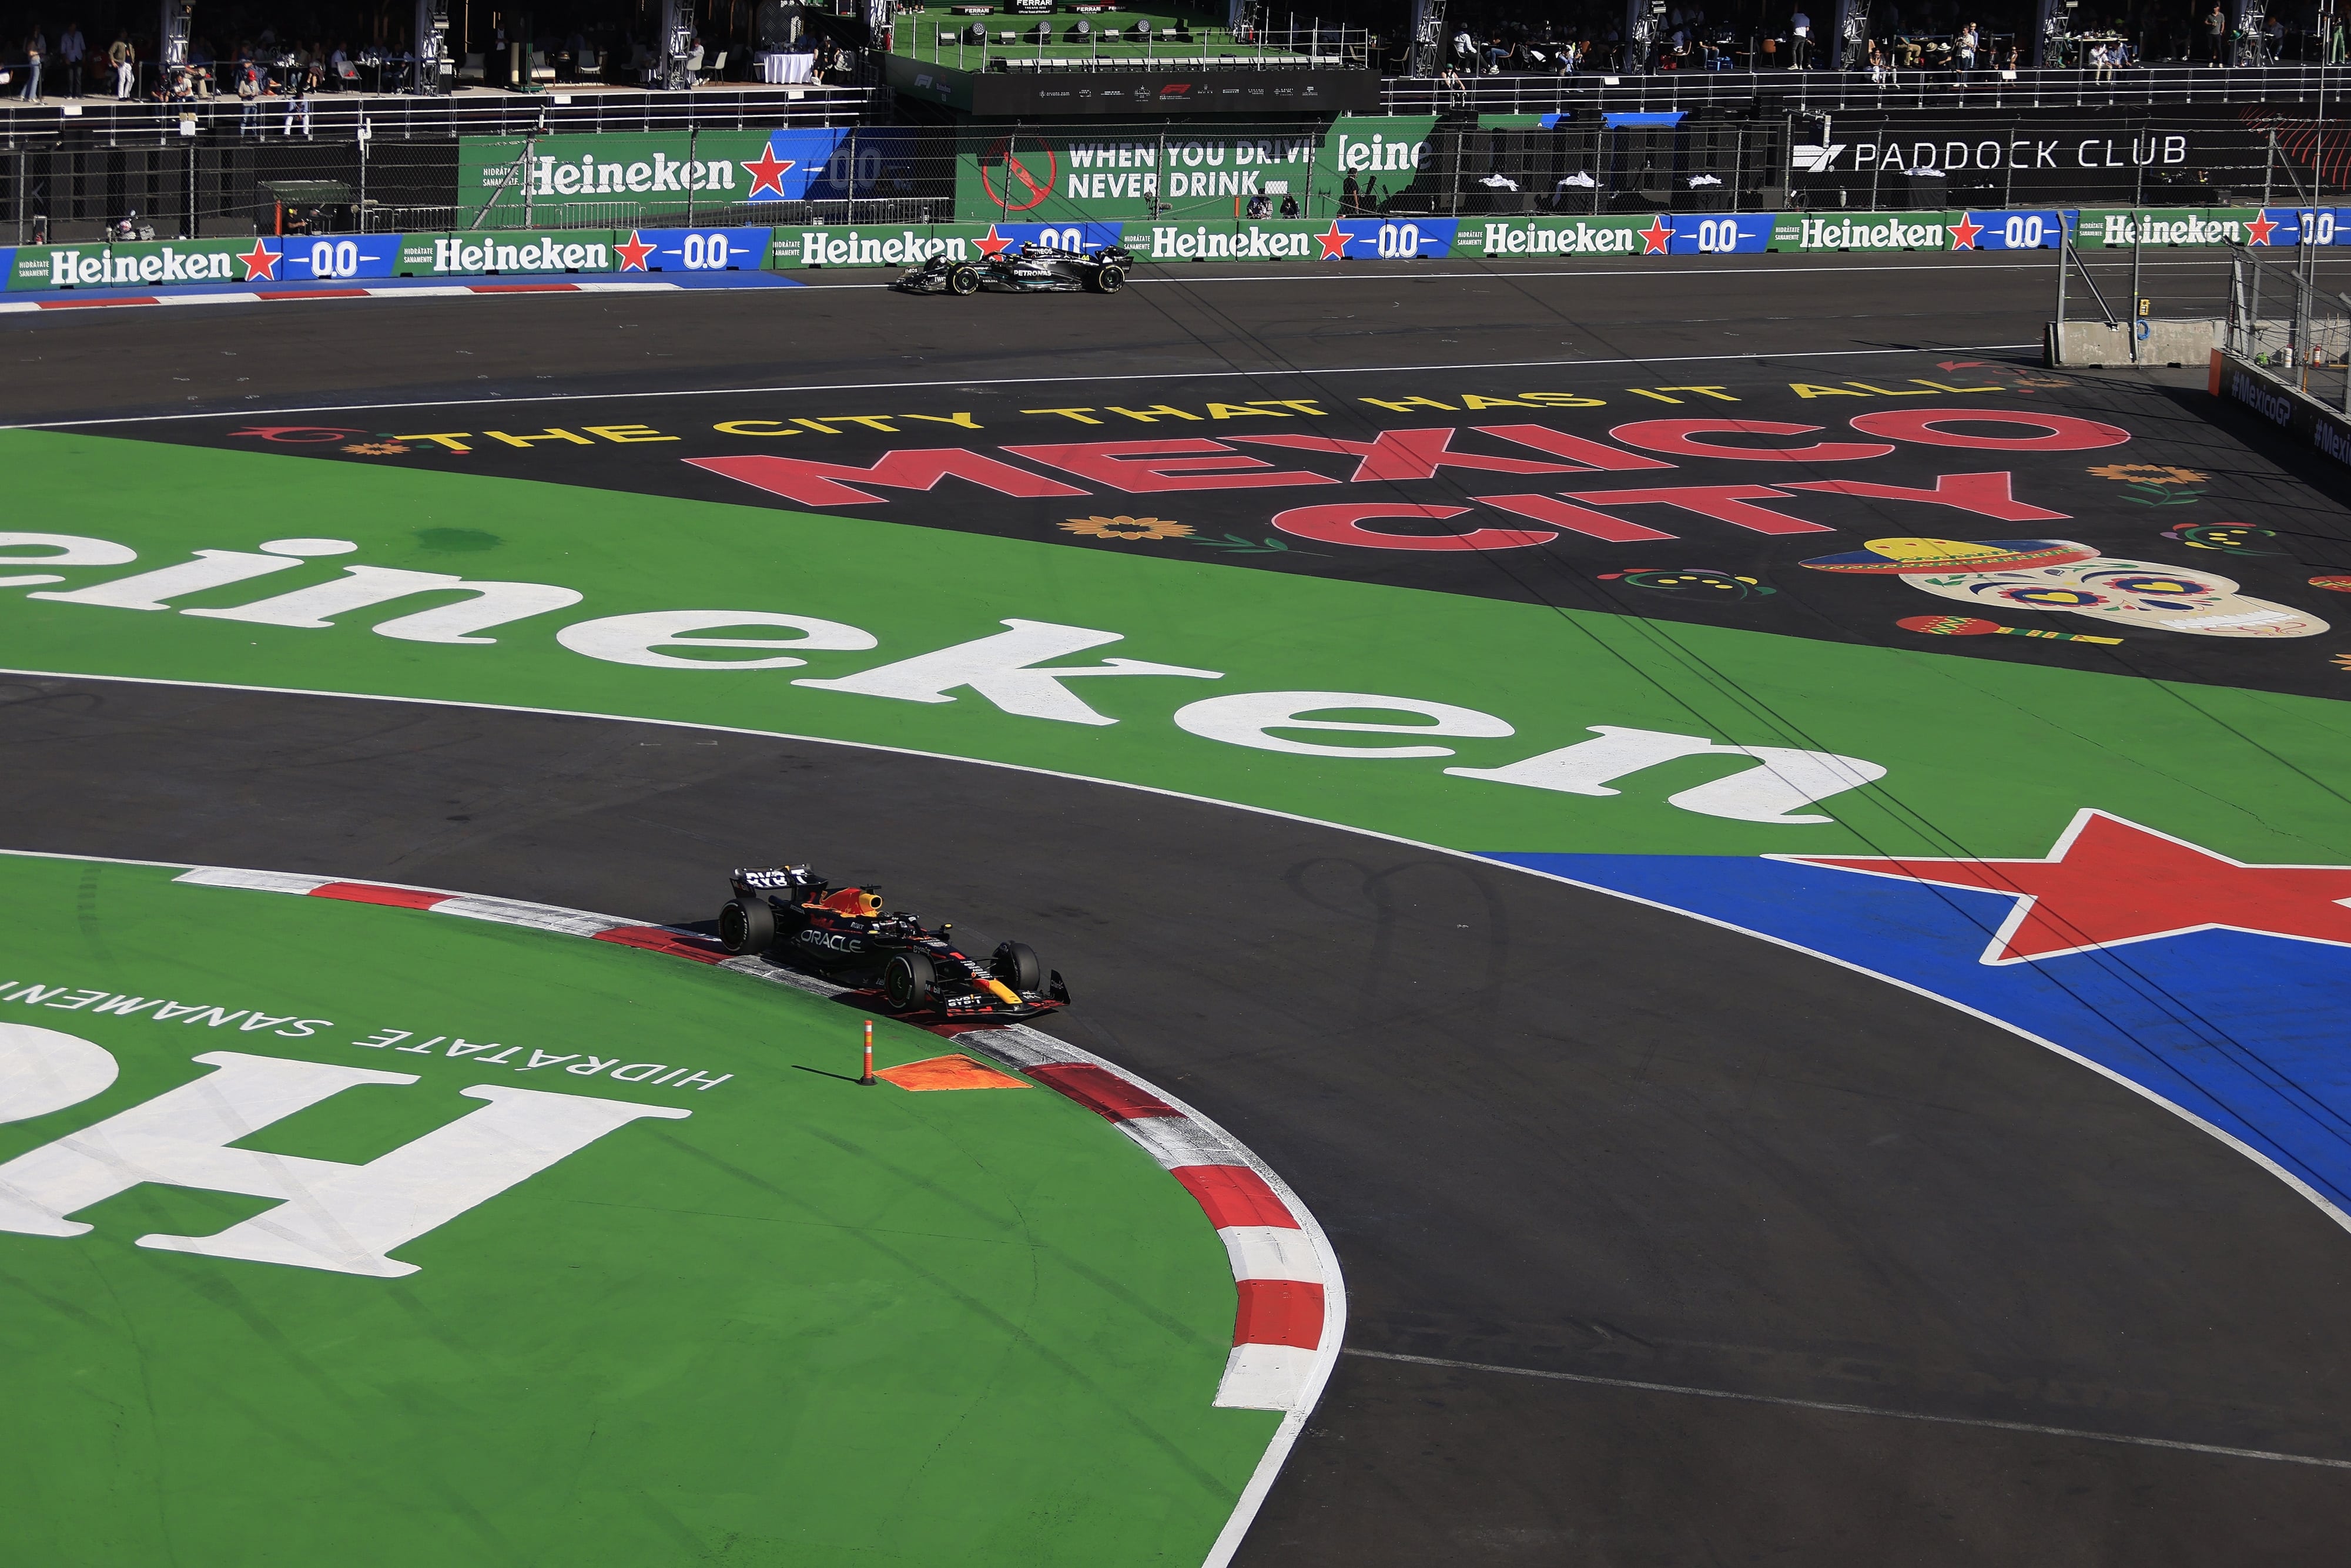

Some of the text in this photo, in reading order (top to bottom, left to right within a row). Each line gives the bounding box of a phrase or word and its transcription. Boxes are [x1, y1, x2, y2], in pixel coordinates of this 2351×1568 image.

[1069, 143, 1155, 168] WHEN
[1166, 141, 1225, 167] YOU
[1855, 136, 2186, 171] PADDOCK CLUB
[483, 166, 519, 176] HIDRÁT
[521, 152, 736, 196] Heineken
[1068, 170, 1261, 199] NEVER DRINK
[1124, 234, 1151, 242] HIDRÁTATE
[1151, 223, 1419, 259] Heineken 0.0
[1483, 219, 1738, 253] Heineken 0.0
[1799, 216, 2044, 249] Heineken 0.0
[2102, 215, 2241, 244] Heineken
[50, 240, 359, 284] Heineken 0.0
[403, 256, 433, 264] SANAMENTE
[404, 246, 433, 254] HIDRÁTATE
[433, 234, 729, 272] Heineken 0.0
[801, 232, 967, 264] Heineken
[394, 379, 2005, 450] THE CITY THAT HAS IT ALL
[2232, 371, 2290, 427] #MexicoGP
[685, 408, 2131, 507] MEXICO
[2314, 418, 2351, 466] #Mexi
[1272, 471, 2072, 551] CITY
[745, 869, 808, 887] BYBT
[801, 930, 866, 953] ORACLE
[352, 1028, 733, 1091] HIDRÁTATE
[0, 1021, 693, 1278] H
